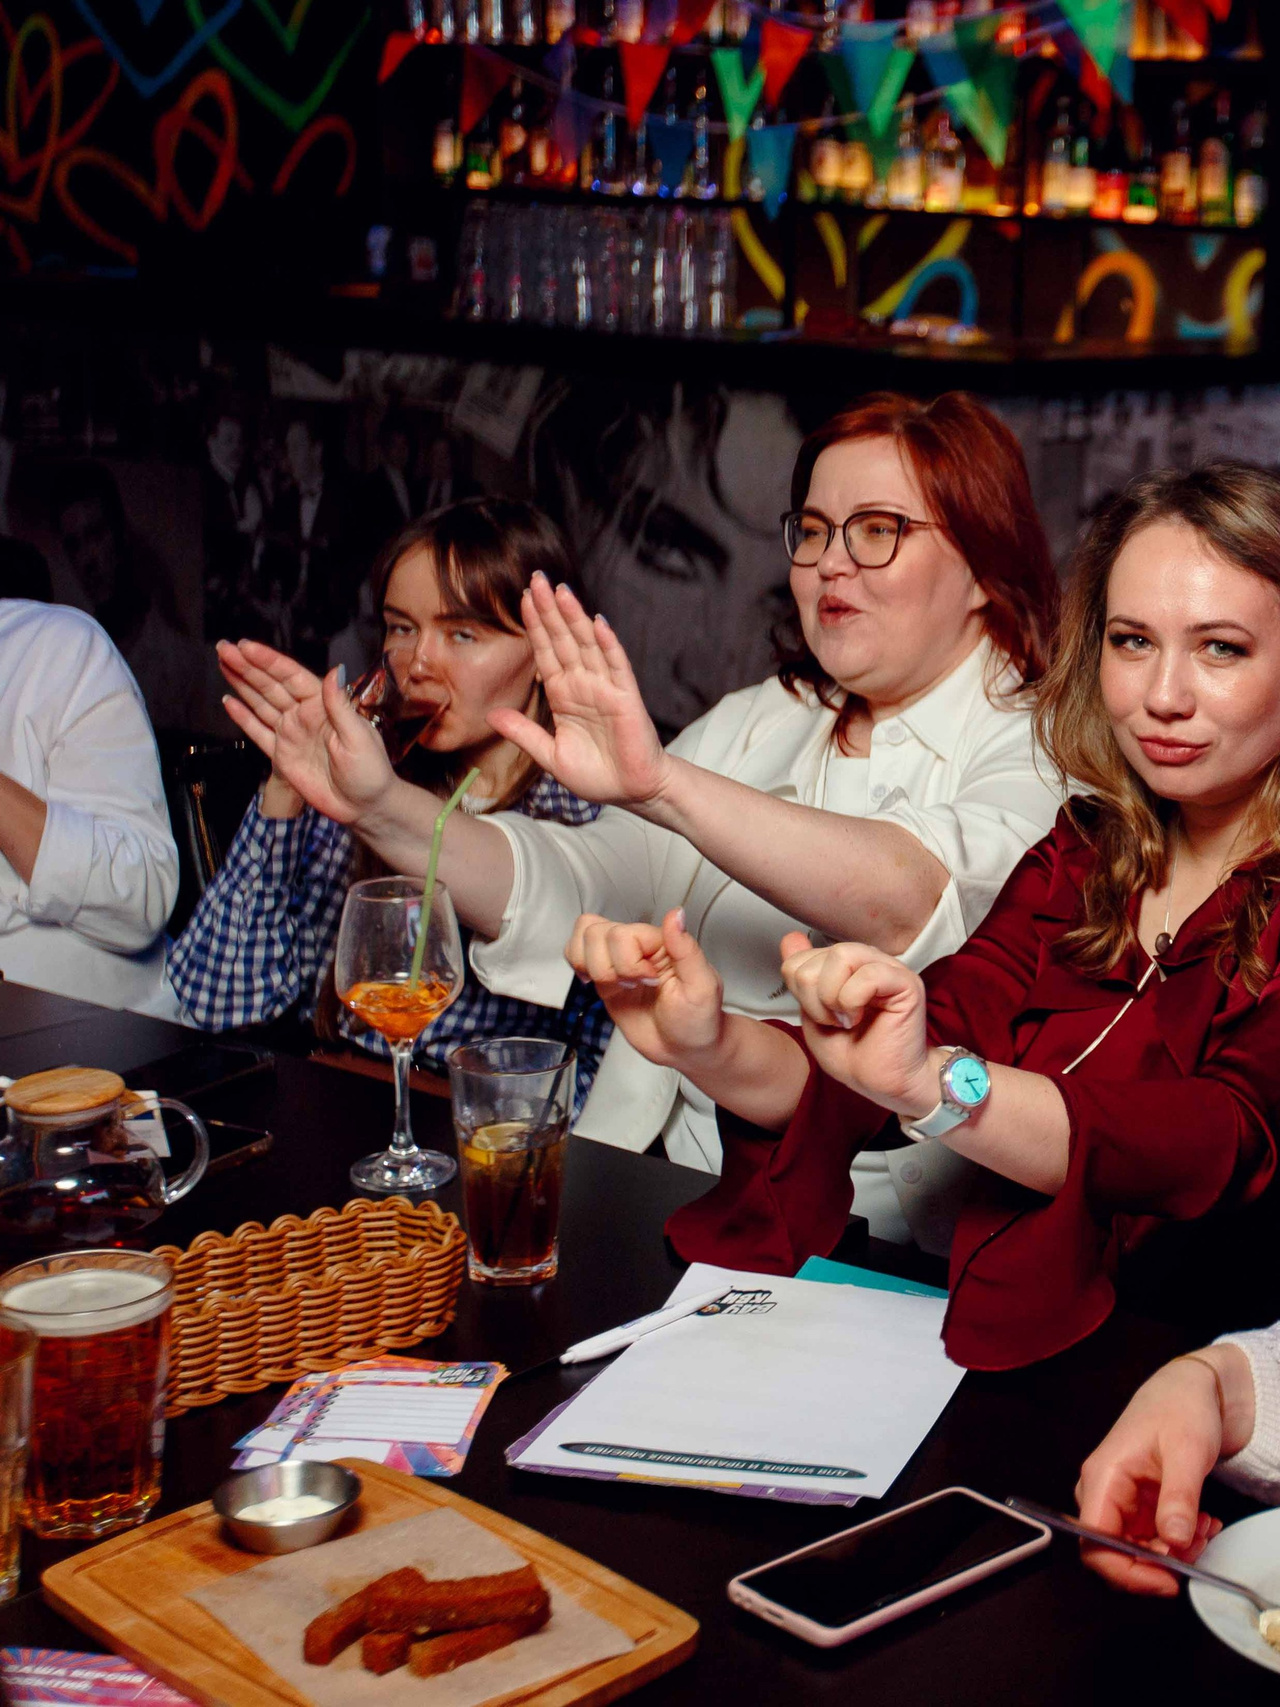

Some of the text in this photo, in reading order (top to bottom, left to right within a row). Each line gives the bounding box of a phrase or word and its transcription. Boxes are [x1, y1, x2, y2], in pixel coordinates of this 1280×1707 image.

[716, 1291, 772, 1304] КВИ
[720, 1302, 777, 1315] ВАУ
[582, 1445, 646, 1459] МЫСЛЕЙ
[648, 1452, 746, 1470] ПРАВИЛЬНЫХ
[761, 1463, 815, 1475] УМНЫХ
[816, 1468, 850, 1477] ДЛЯ
